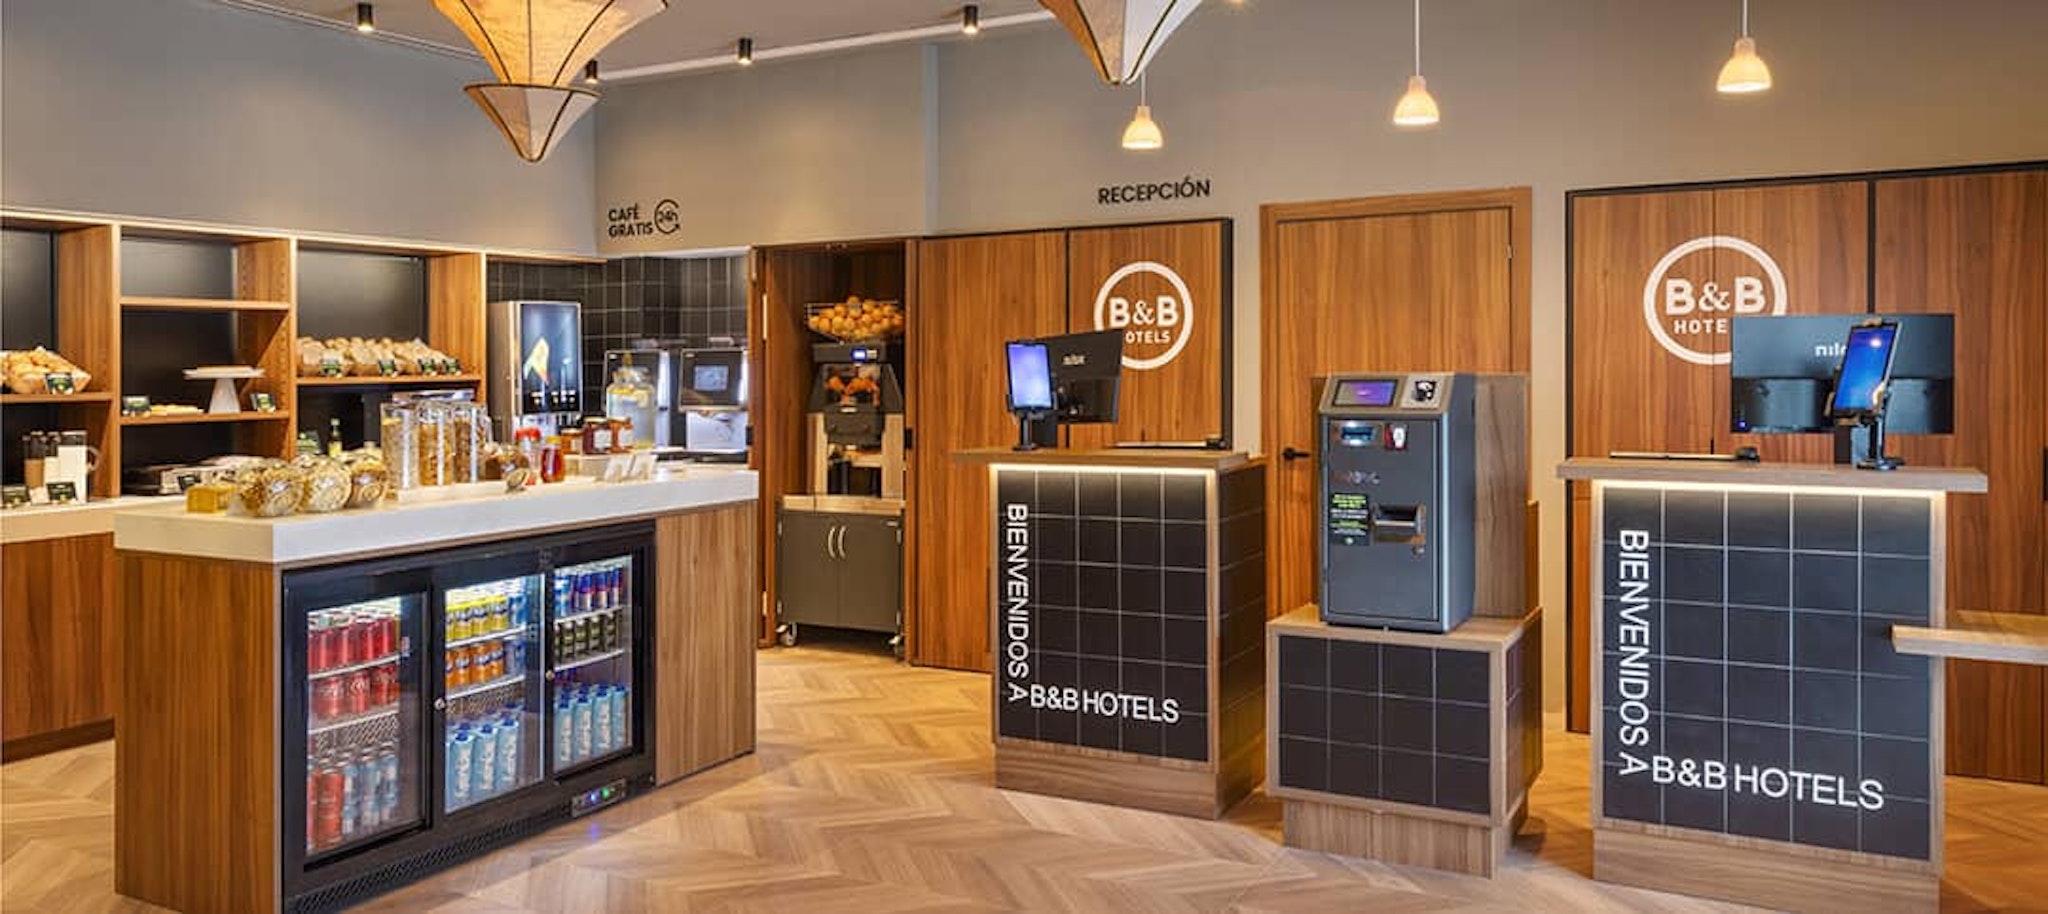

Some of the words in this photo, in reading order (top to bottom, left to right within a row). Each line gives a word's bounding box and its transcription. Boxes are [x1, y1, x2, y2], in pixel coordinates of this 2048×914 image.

[1098, 176, 1211, 204] RECEPCIÓN
[608, 203, 640, 221] CAFÉ
[608, 222, 653, 237] GRATIS
[1666, 276, 1766, 315] B&B
[1109, 295, 1179, 328] B&B
[1125, 330, 1171, 344] OTELS
[1674, 319, 1728, 334] HOTE
[1007, 504, 1029, 678] BIENVENIDOS
[1619, 530, 1649, 746] BIENVENIDOS
[1008, 682, 1029, 702] A
[1030, 684, 1079, 711] B&B
[1083, 690, 1179, 724] HOTELS
[1619, 751, 1649, 775] A
[1652, 755, 1727, 790] B&B
[1734, 763, 1884, 810] HOTELS
